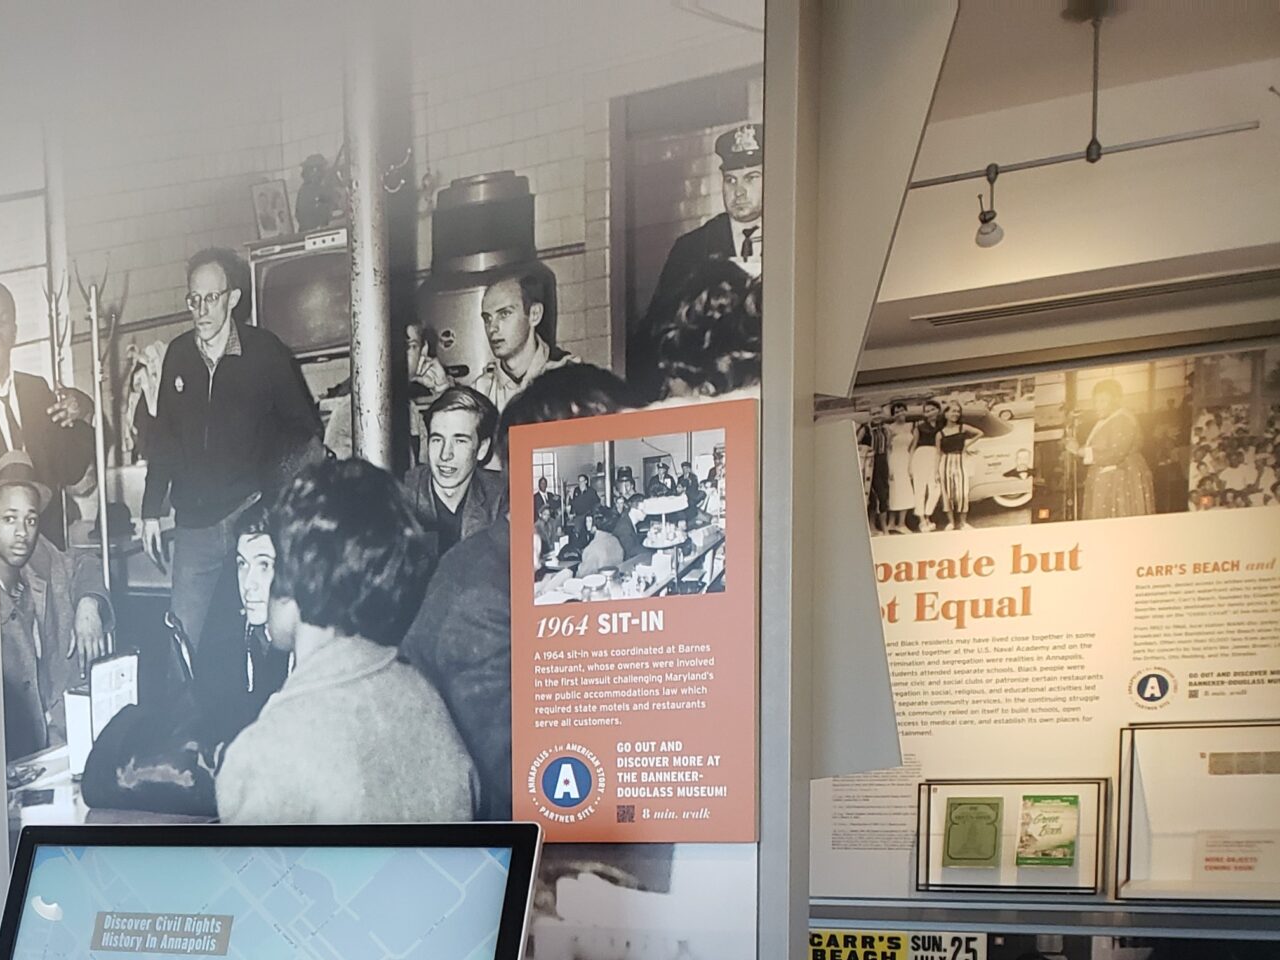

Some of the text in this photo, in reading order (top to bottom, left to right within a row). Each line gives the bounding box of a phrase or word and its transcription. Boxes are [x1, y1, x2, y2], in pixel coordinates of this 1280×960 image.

[875, 542, 1083, 583] parate but
[1136, 557, 1277, 578] CARR'S BEACH and
[914, 585, 1032, 630] Equal
[536, 610, 665, 638] 1964 SIT-IN
[534, 644, 711, 661] A 1964 sit-in was coordinated at Barnes
[534, 656, 715, 674] Restaurant, whose owners were involved
[534, 670, 714, 688] in the first lawsuit challenging Maryland's
[534, 685, 708, 702] new public accommodations law which
[534, 700, 706, 716] required state motels and restaurants
[535, 716, 622, 728] serve all customers.
[616, 741, 683, 753] GO OUT AND
[566, 743, 599, 768] AMERICAN
[596, 767, 606, 795] STORY
[616, 755, 721, 768] DISCOVER MORE AT
[528, 749, 549, 793] ANNAPOLIS
[616, 771, 704, 783] THE BANNEKER-
[553, 763, 580, 799] A
[616, 786, 727, 798] DOUGLASS MUSEUM!
[538, 805, 595, 823] PARTNER SITE
[642, 808, 711, 819] 8 min. walk
[103, 915, 222, 936] Discover Civil Rights
[101, 932, 217, 953] History In Annapolis
[809, 932, 902, 950] CARR'S
[910, 935, 948, 953] SUN.
